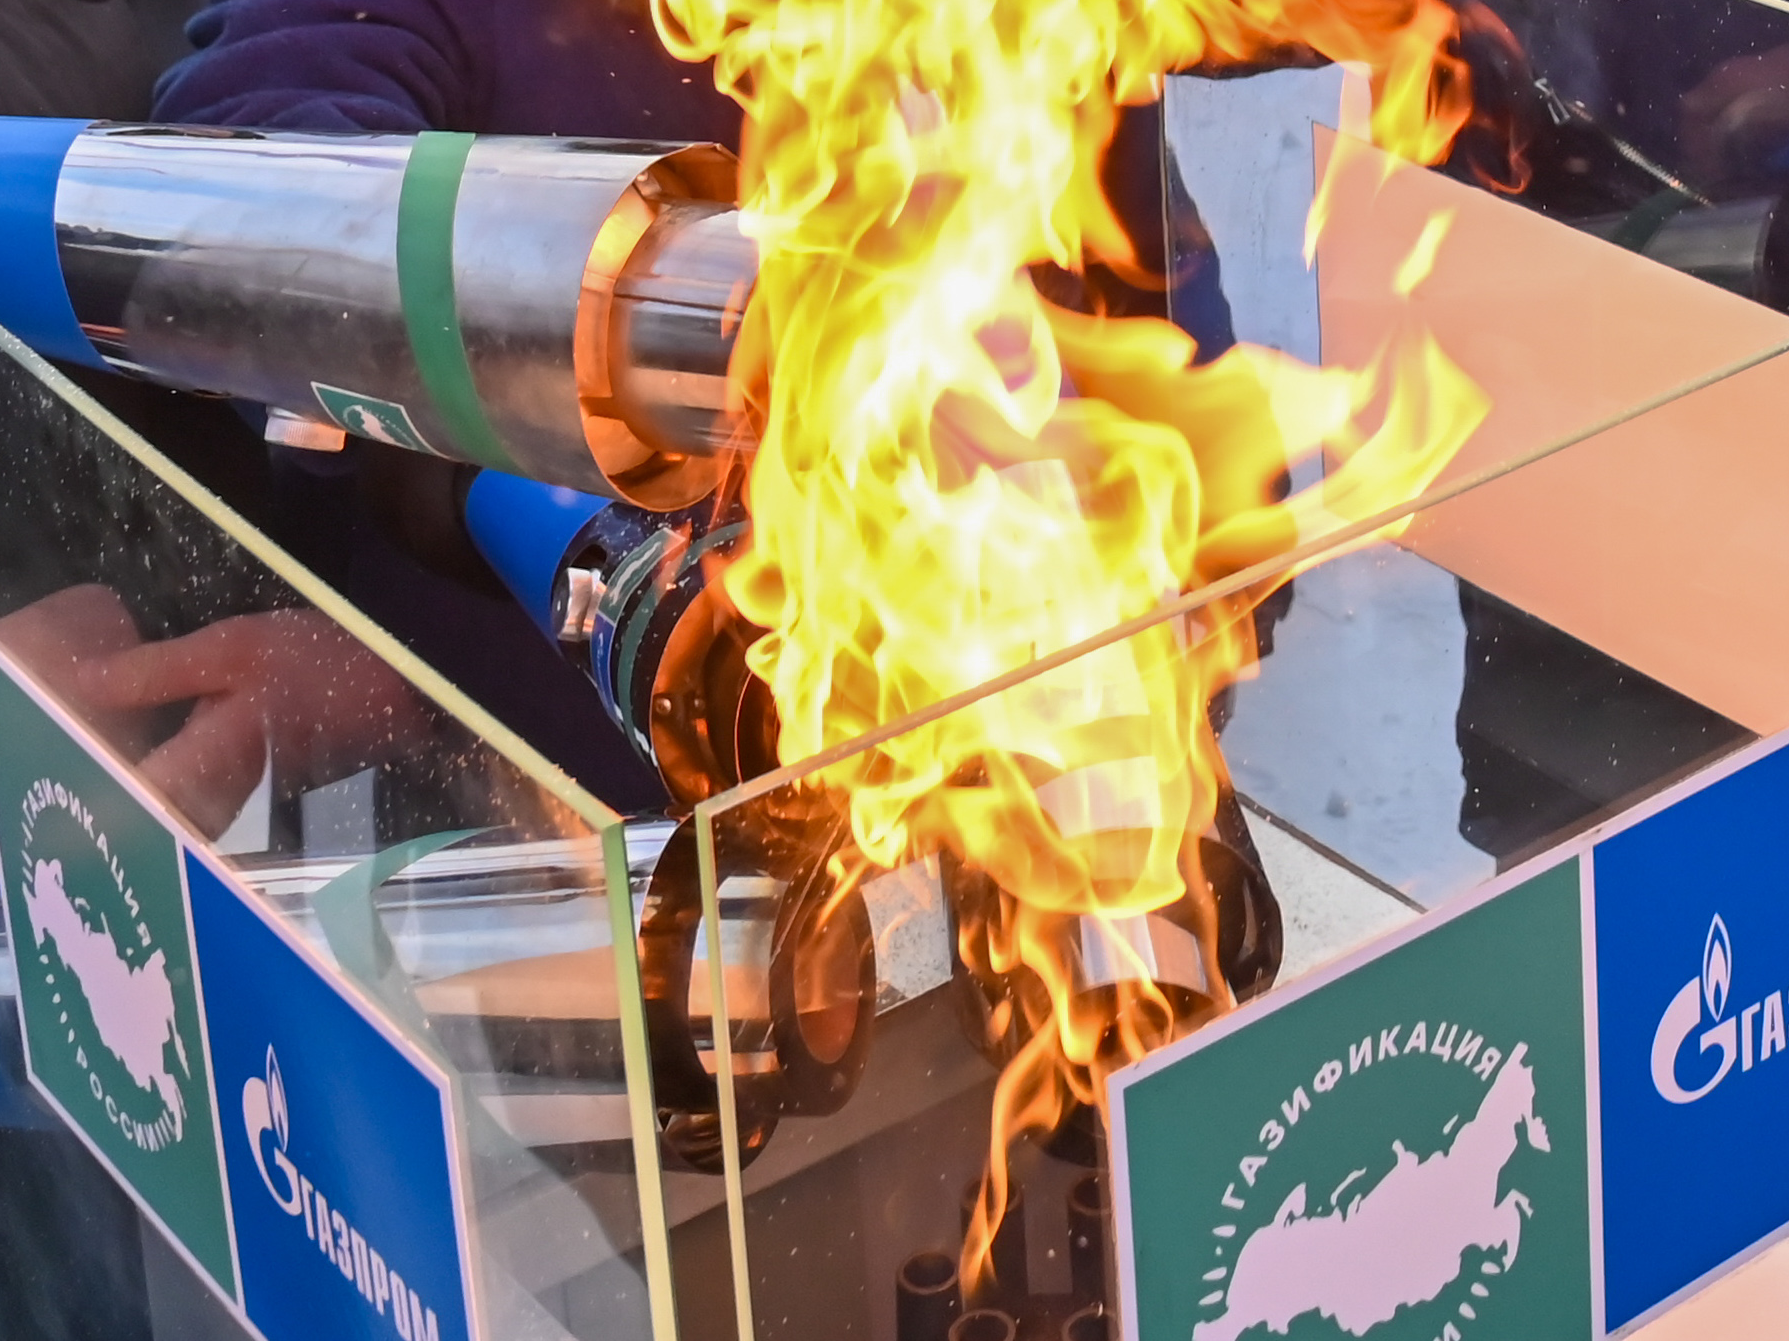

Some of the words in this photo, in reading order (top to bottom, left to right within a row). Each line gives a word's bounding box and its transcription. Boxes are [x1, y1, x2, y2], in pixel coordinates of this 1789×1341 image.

[22, 778, 152, 947] ГАЗИФИКАЦИЯ
[75, 1044, 160, 1152] РОССИИ
[1221, 1020, 1502, 1210] ГАЗИФИКАЦИЯ
[300, 1173, 440, 1341] ГАЗПРОМ
